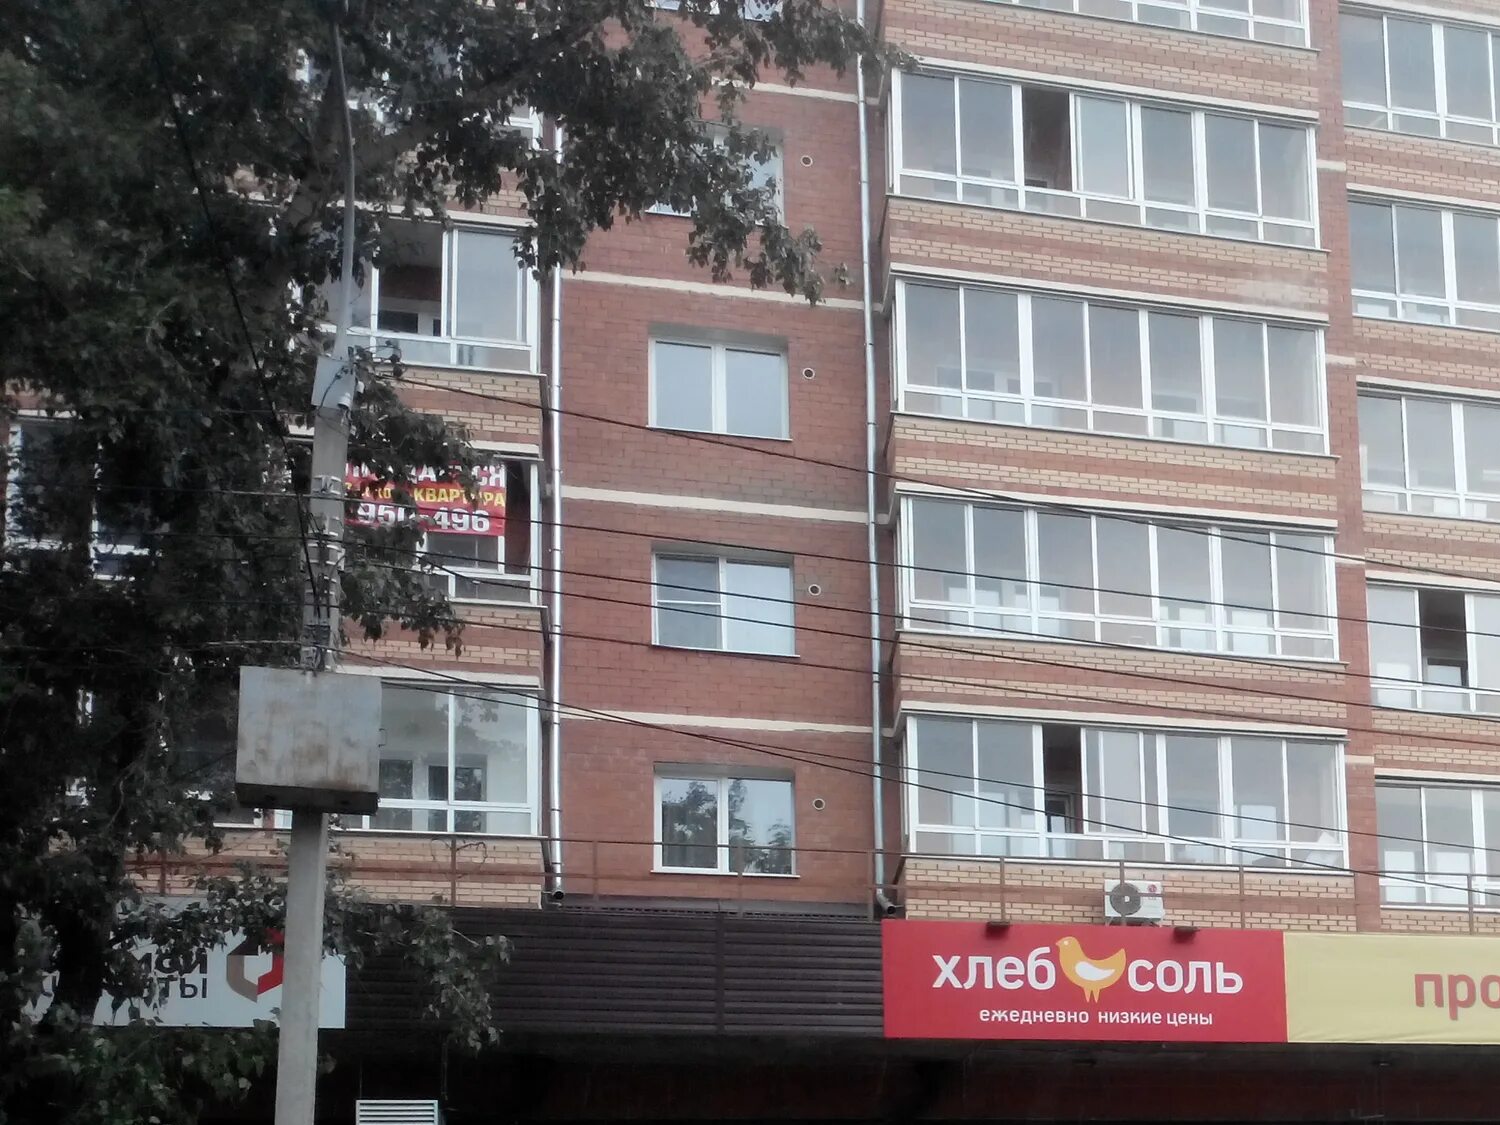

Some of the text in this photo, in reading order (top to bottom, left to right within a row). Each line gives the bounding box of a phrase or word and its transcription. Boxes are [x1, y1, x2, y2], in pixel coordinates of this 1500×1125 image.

[414, 487, 506, 507] КВАРТРА
[932, 946, 1243, 994] хлеб соль
[979, 1008, 1213, 1027] ежедневно низкие цены
